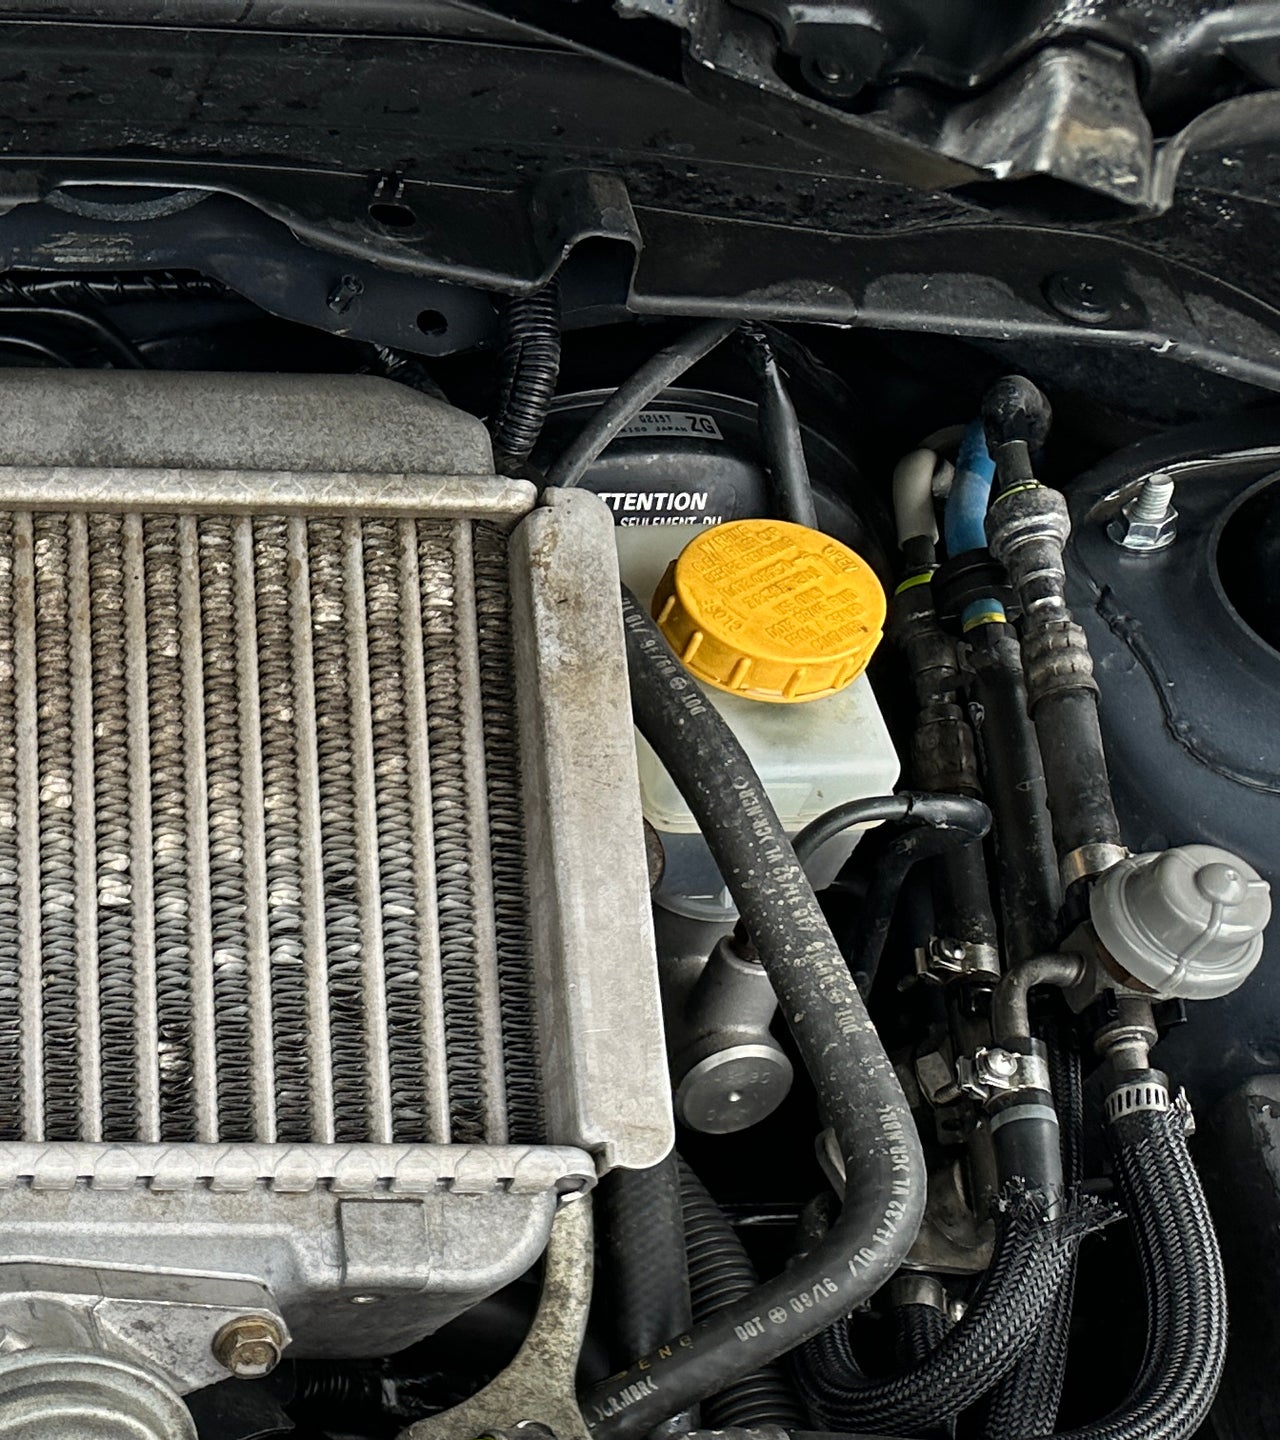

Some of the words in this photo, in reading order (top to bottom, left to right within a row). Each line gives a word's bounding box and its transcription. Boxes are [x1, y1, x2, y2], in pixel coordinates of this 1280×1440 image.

[685, 414, 717, 434] ZG
[597, 492, 708, 511] TTENTION
[681, 692, 707, 717] DOT
[733, 1316, 767, 1342] DOT
[847, 1247, 877, 1277] /10
